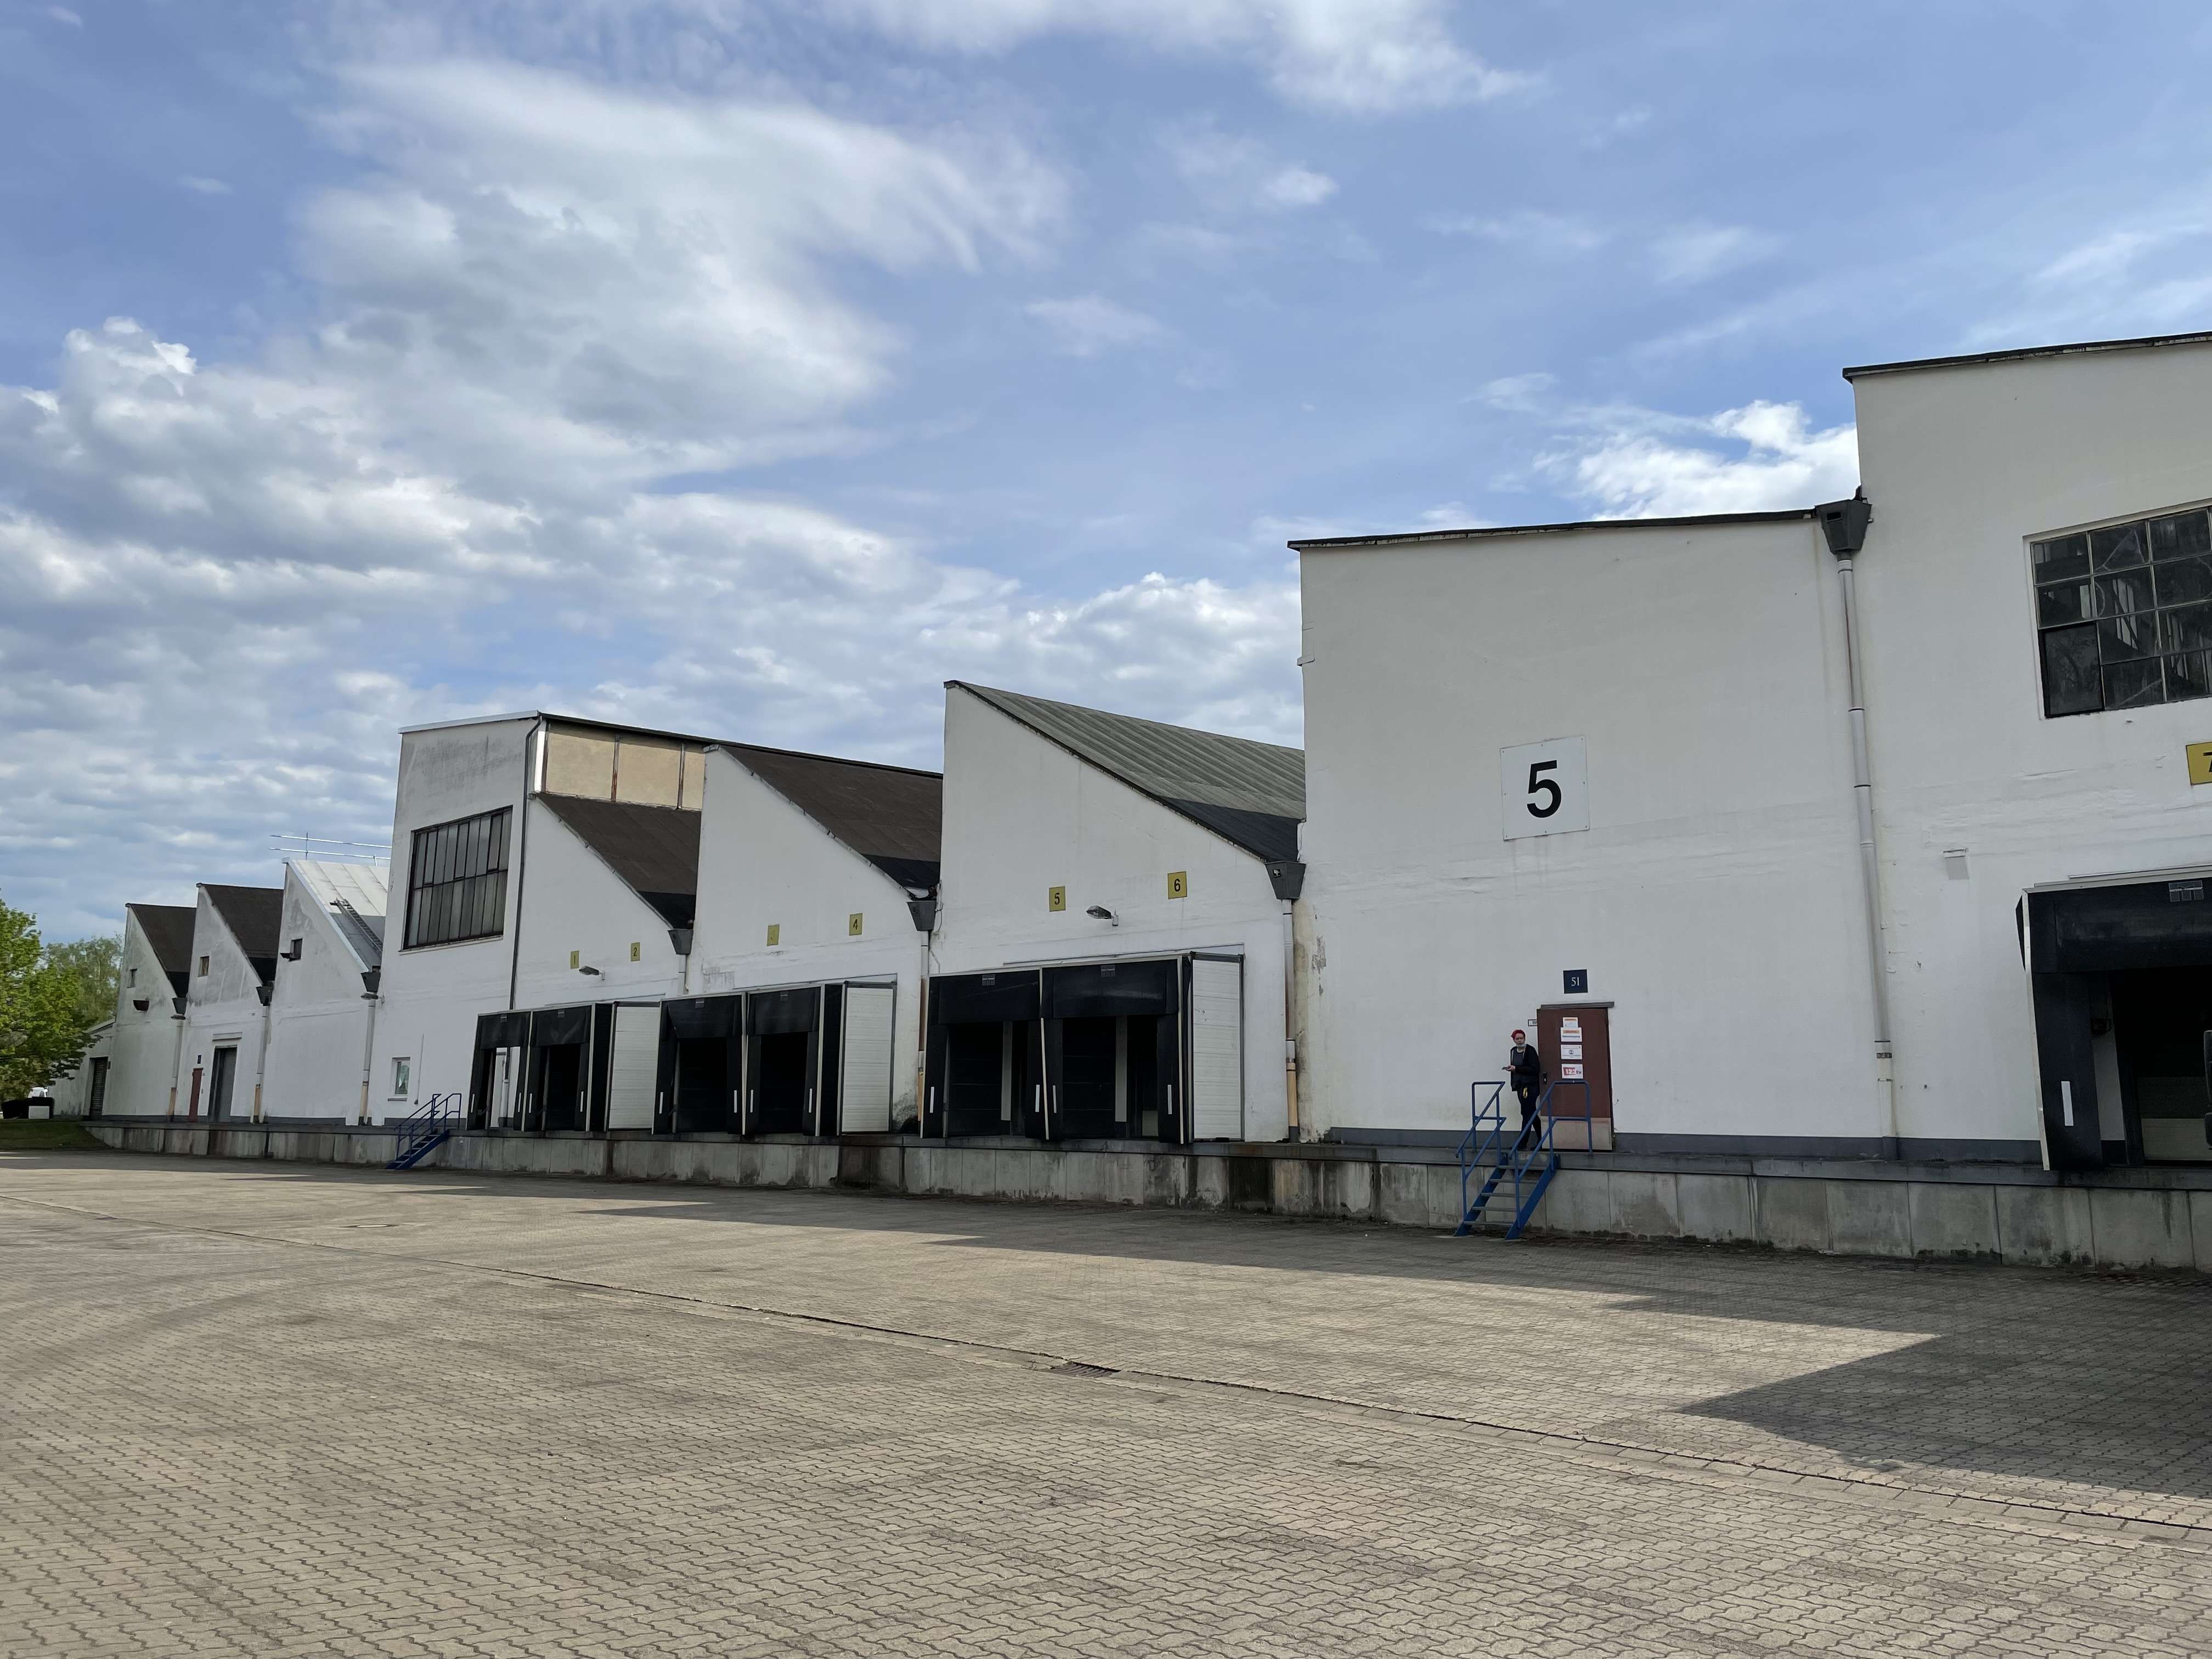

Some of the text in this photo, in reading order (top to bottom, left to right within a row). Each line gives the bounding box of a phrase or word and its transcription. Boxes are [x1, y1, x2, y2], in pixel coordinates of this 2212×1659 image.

[2203, 752, 2212, 772] 7
[1527, 760, 1562, 818] 5
[1173, 878, 1181, 892] 6
[1054, 892, 1060, 905] 5
[853, 919, 858, 930] 4
[633, 947, 637, 957] 2
[1571, 977, 1579, 986] 51
